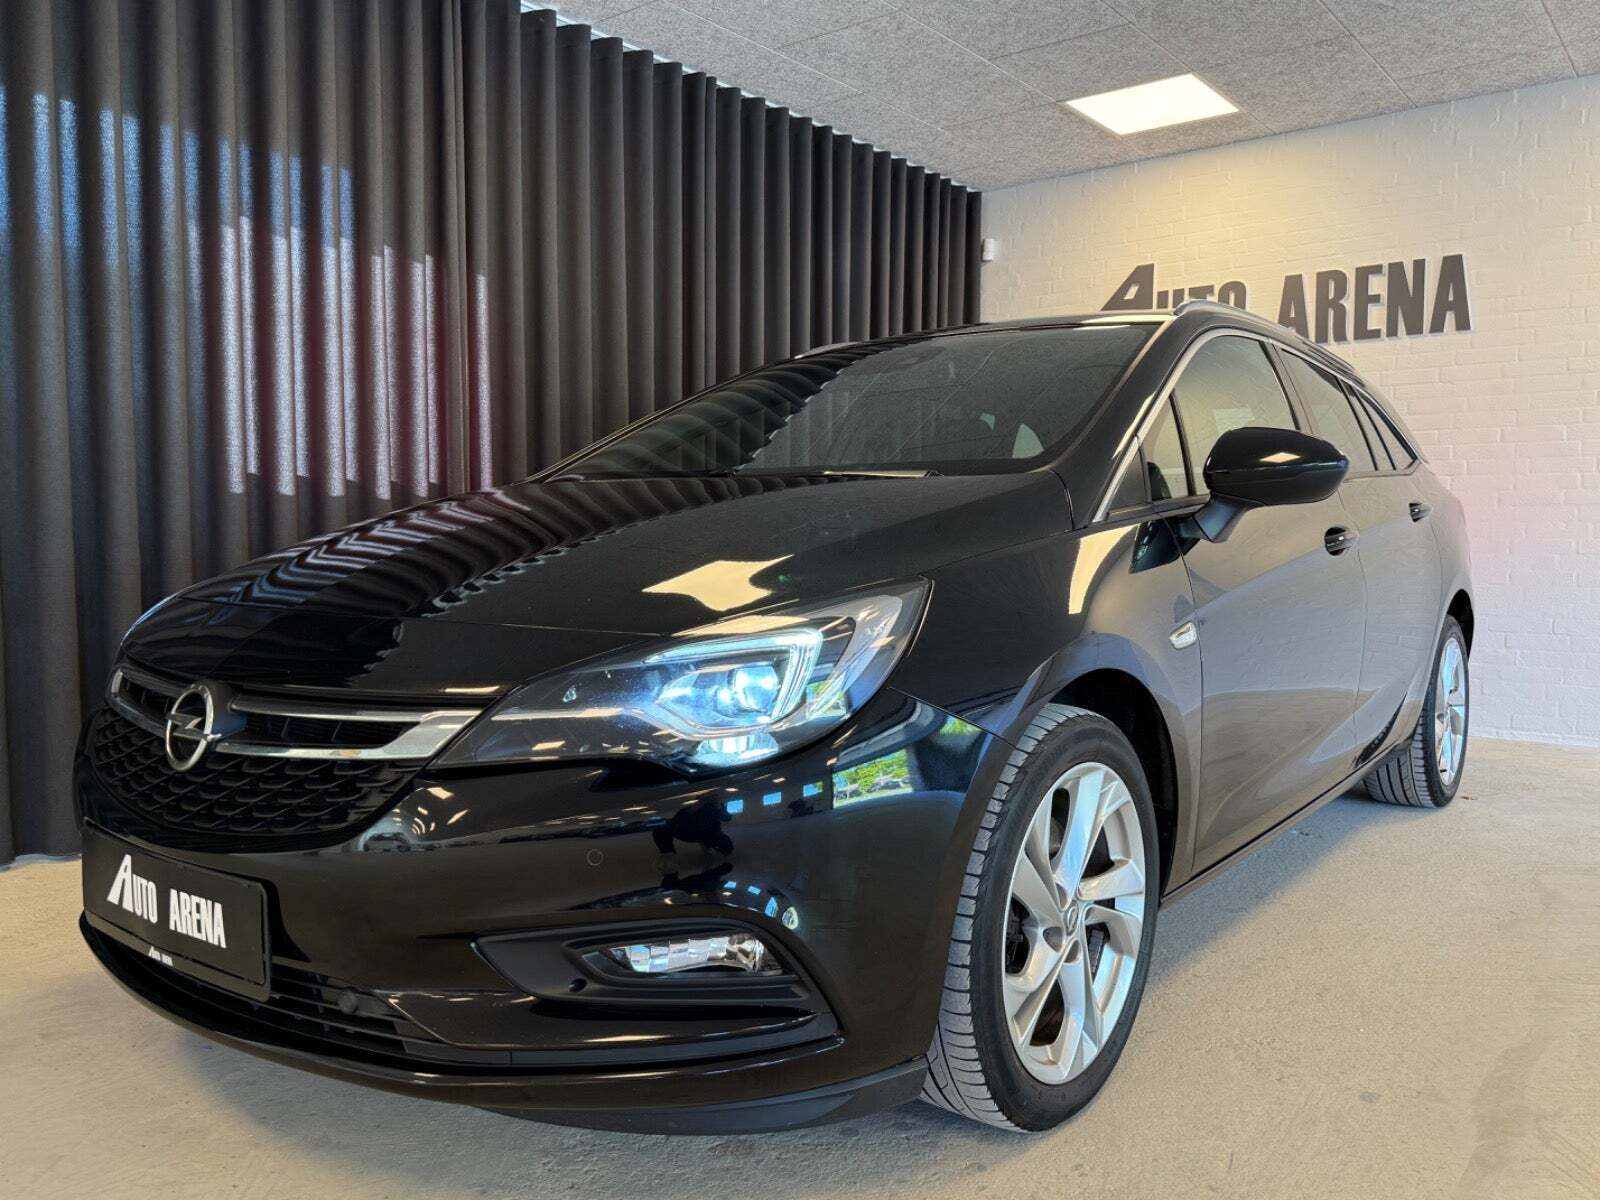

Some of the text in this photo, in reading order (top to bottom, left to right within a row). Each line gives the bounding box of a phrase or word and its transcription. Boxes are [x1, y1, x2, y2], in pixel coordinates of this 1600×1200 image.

[1277, 254, 1471, 343] ARENA
[107, 854, 227, 948] AUTO ARENA
